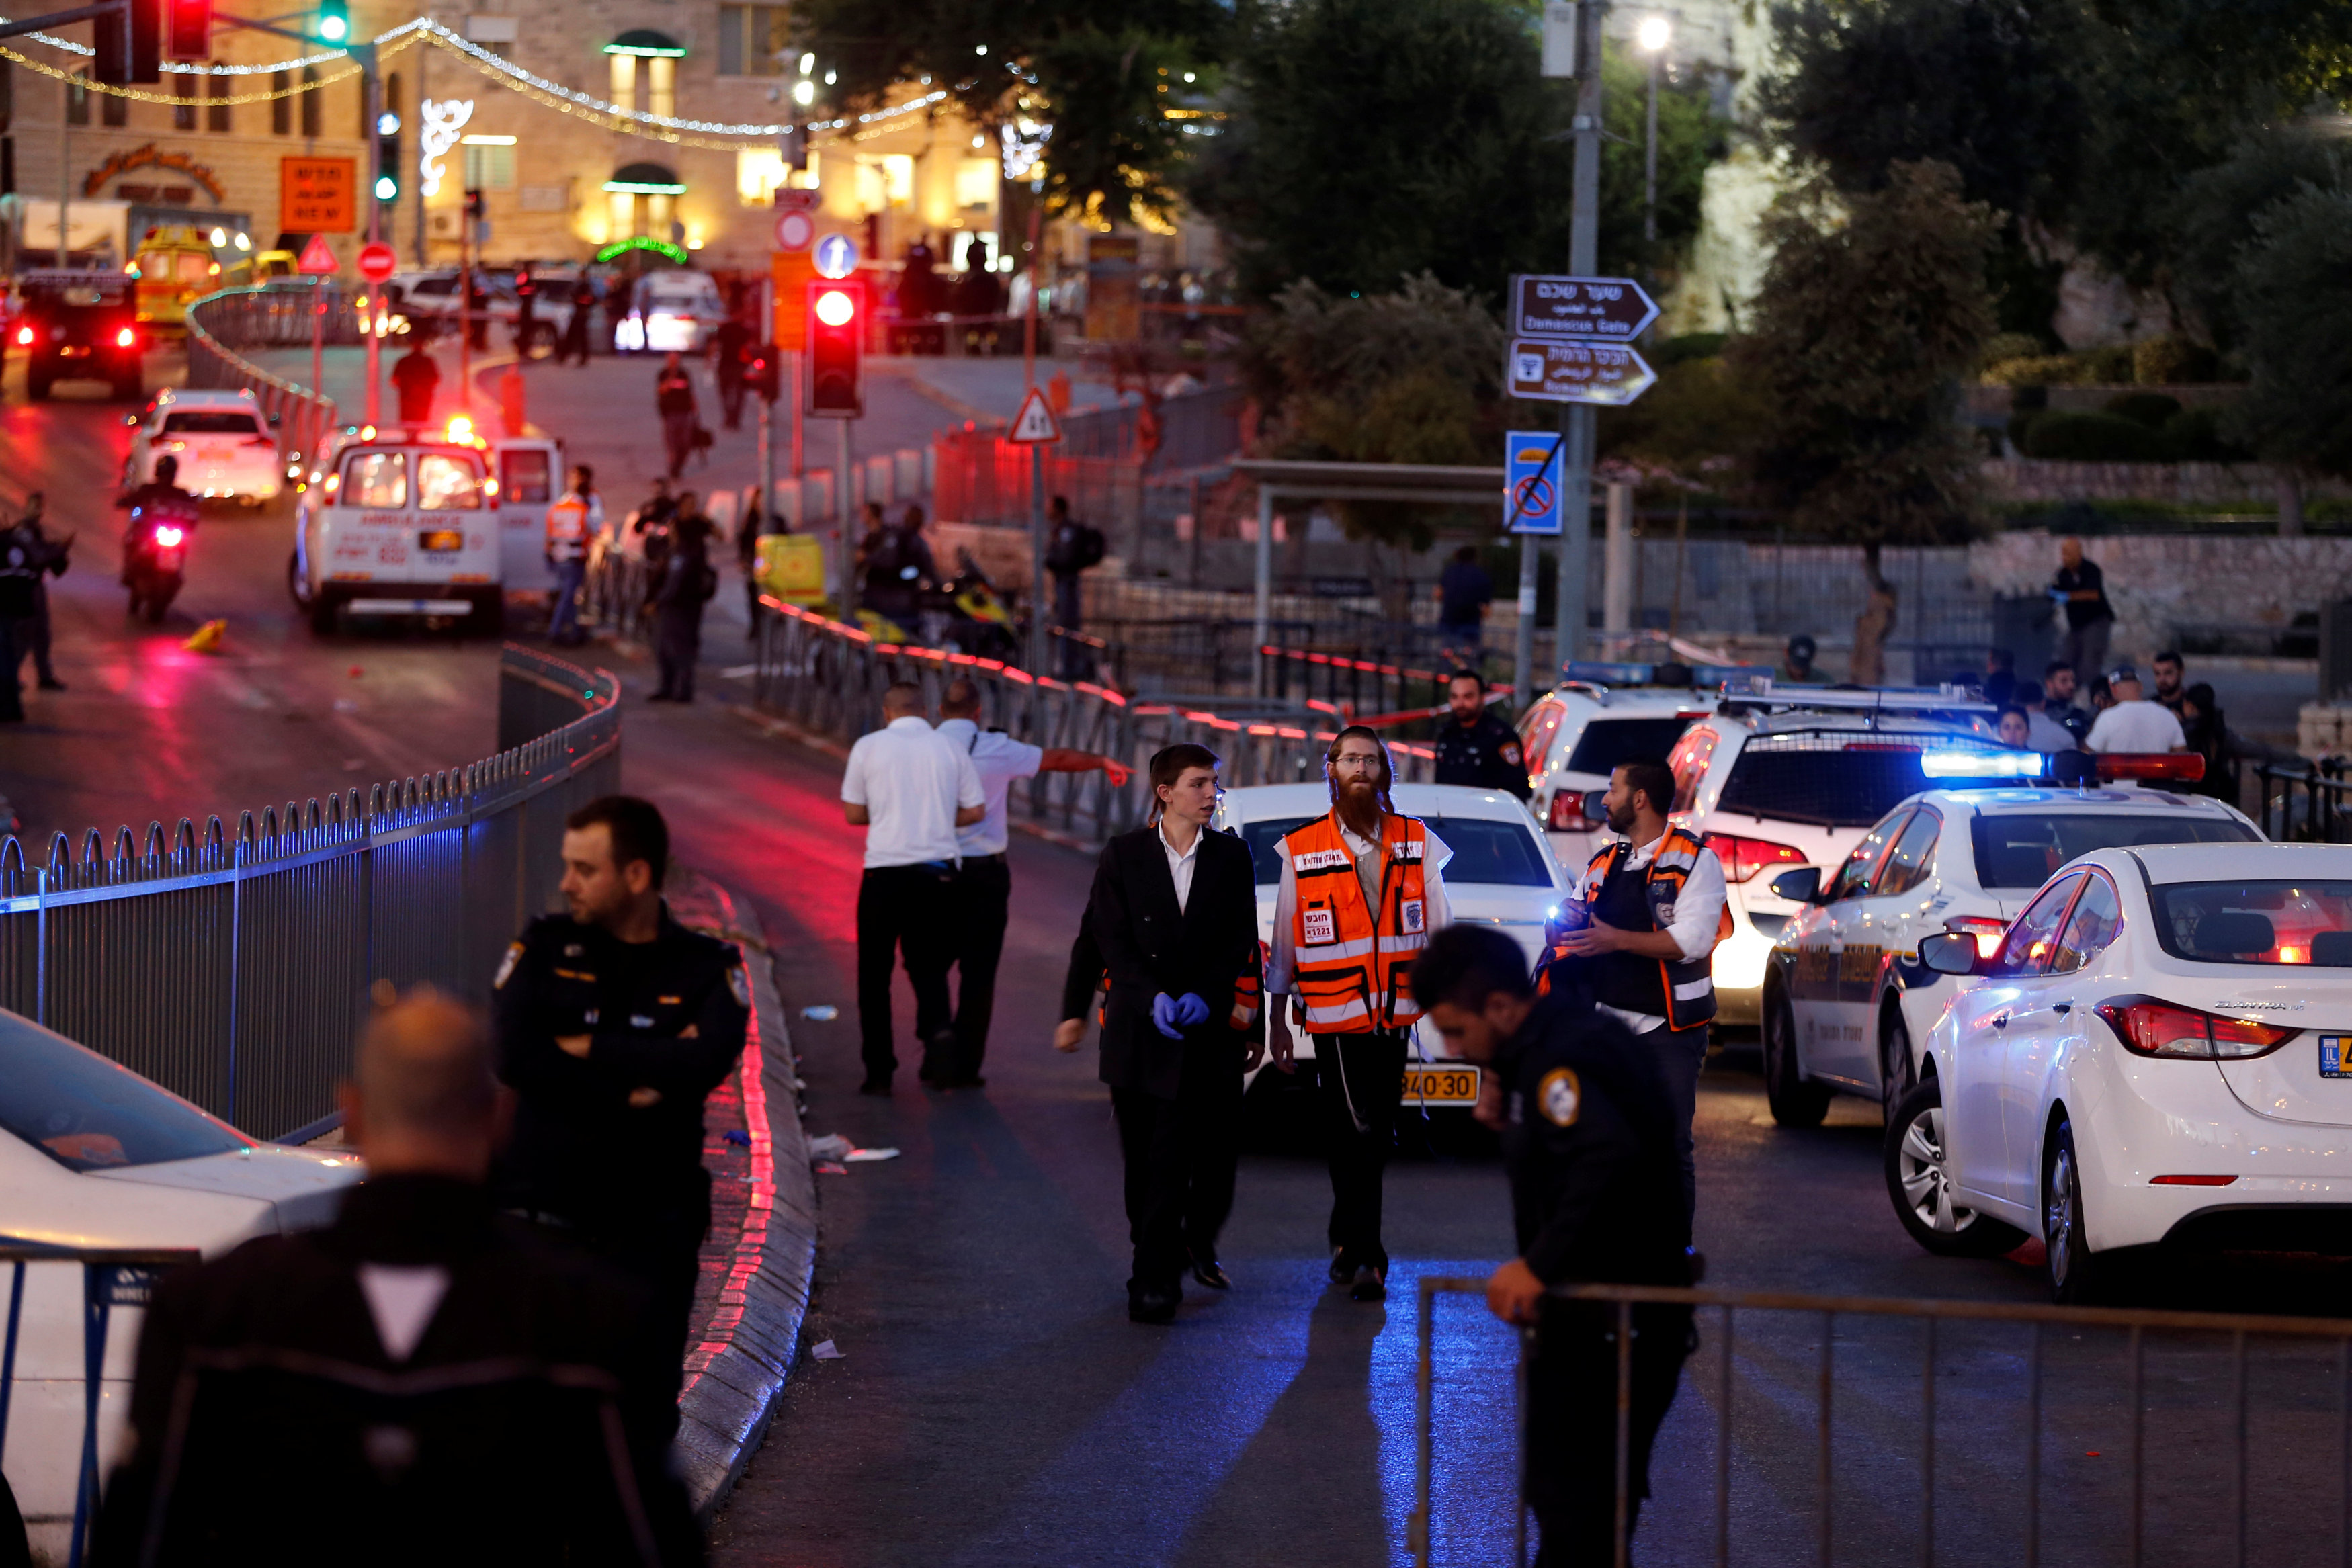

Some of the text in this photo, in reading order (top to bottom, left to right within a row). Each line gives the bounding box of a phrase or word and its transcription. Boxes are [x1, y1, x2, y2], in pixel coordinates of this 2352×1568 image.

[1524, 315, 1632, 334] Damascus Gate
[1306, 914, 1327, 922] חובש
[2215, 1000, 2286, 1010] ELANTRA
[2326, 1047, 2337, 1061] IL
